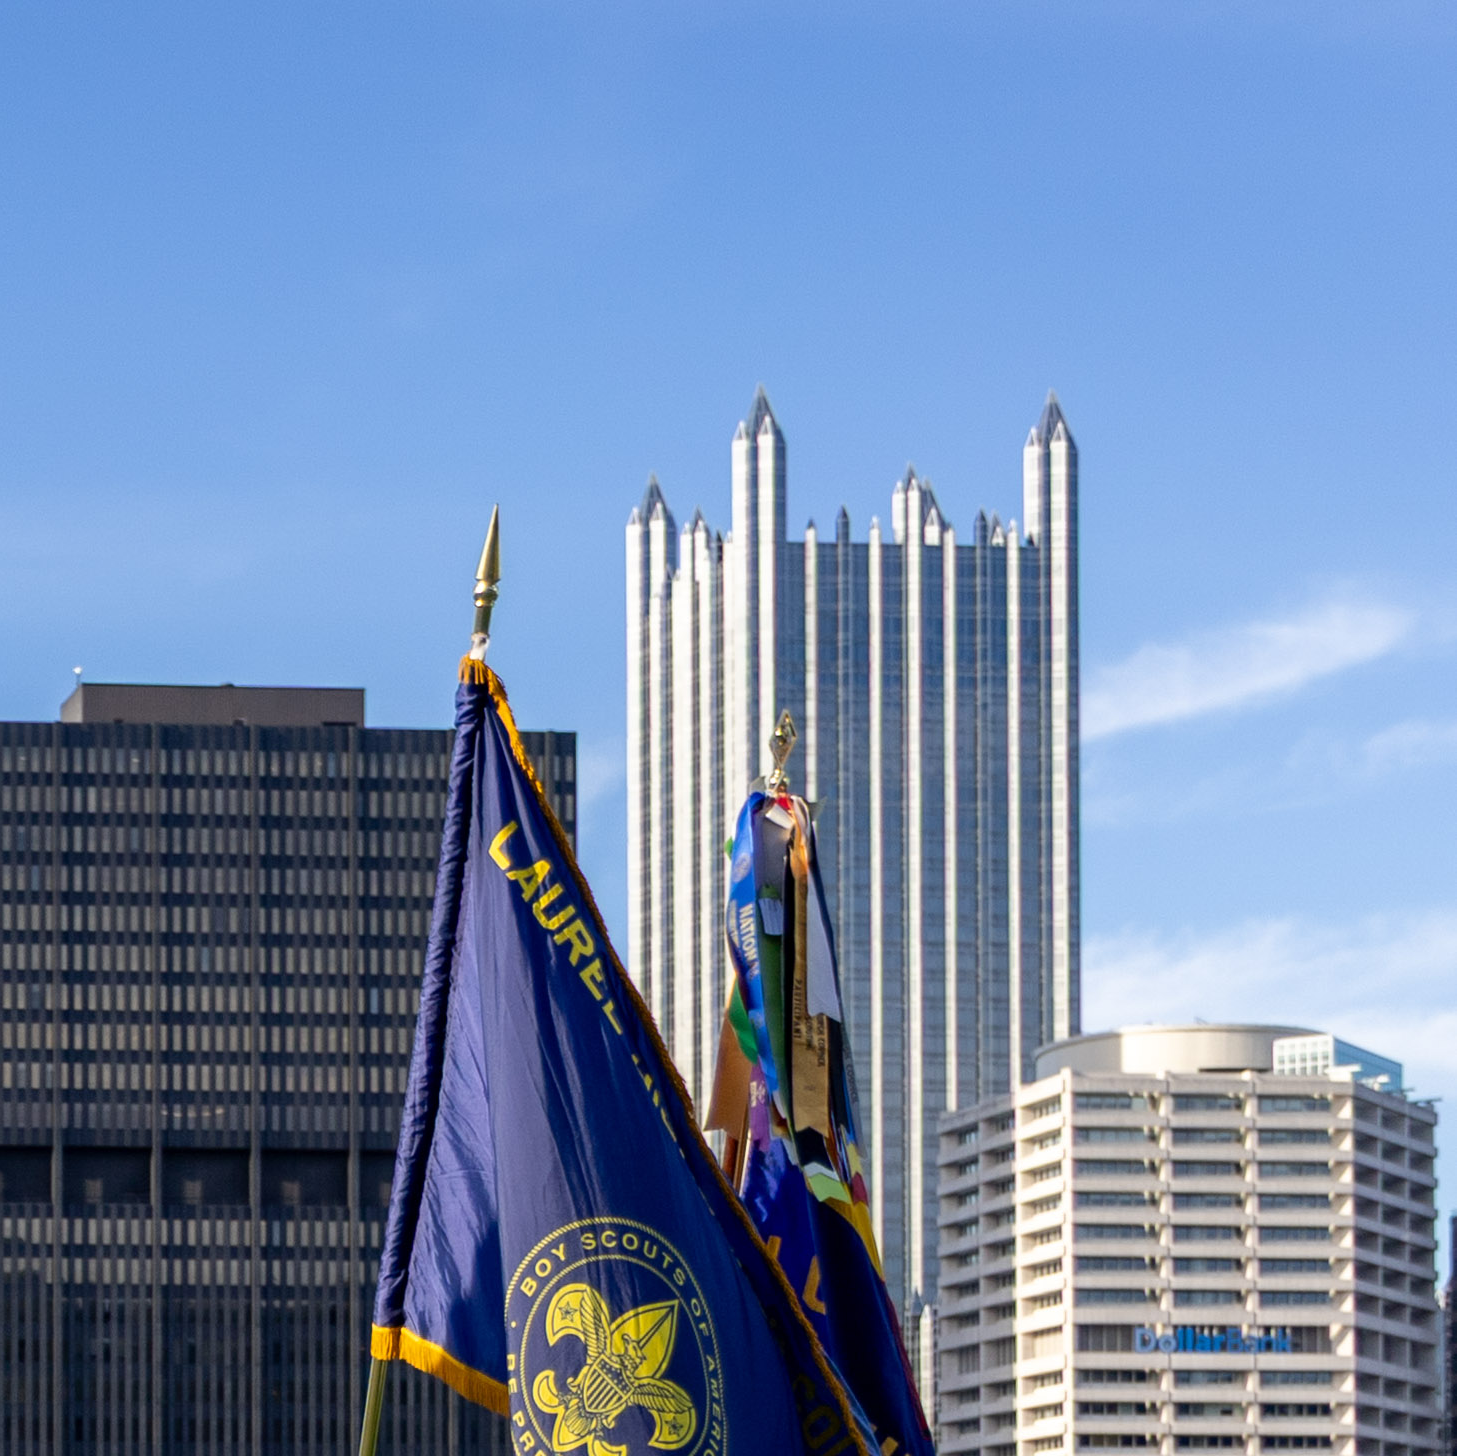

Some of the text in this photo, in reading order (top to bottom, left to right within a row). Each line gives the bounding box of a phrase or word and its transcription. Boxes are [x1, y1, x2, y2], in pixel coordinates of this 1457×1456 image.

[520, 1244, 567, 1298] BOY
[581, 1230, 686, 1287] SCOUTS
[690, 1297, 710, 1338] OF
